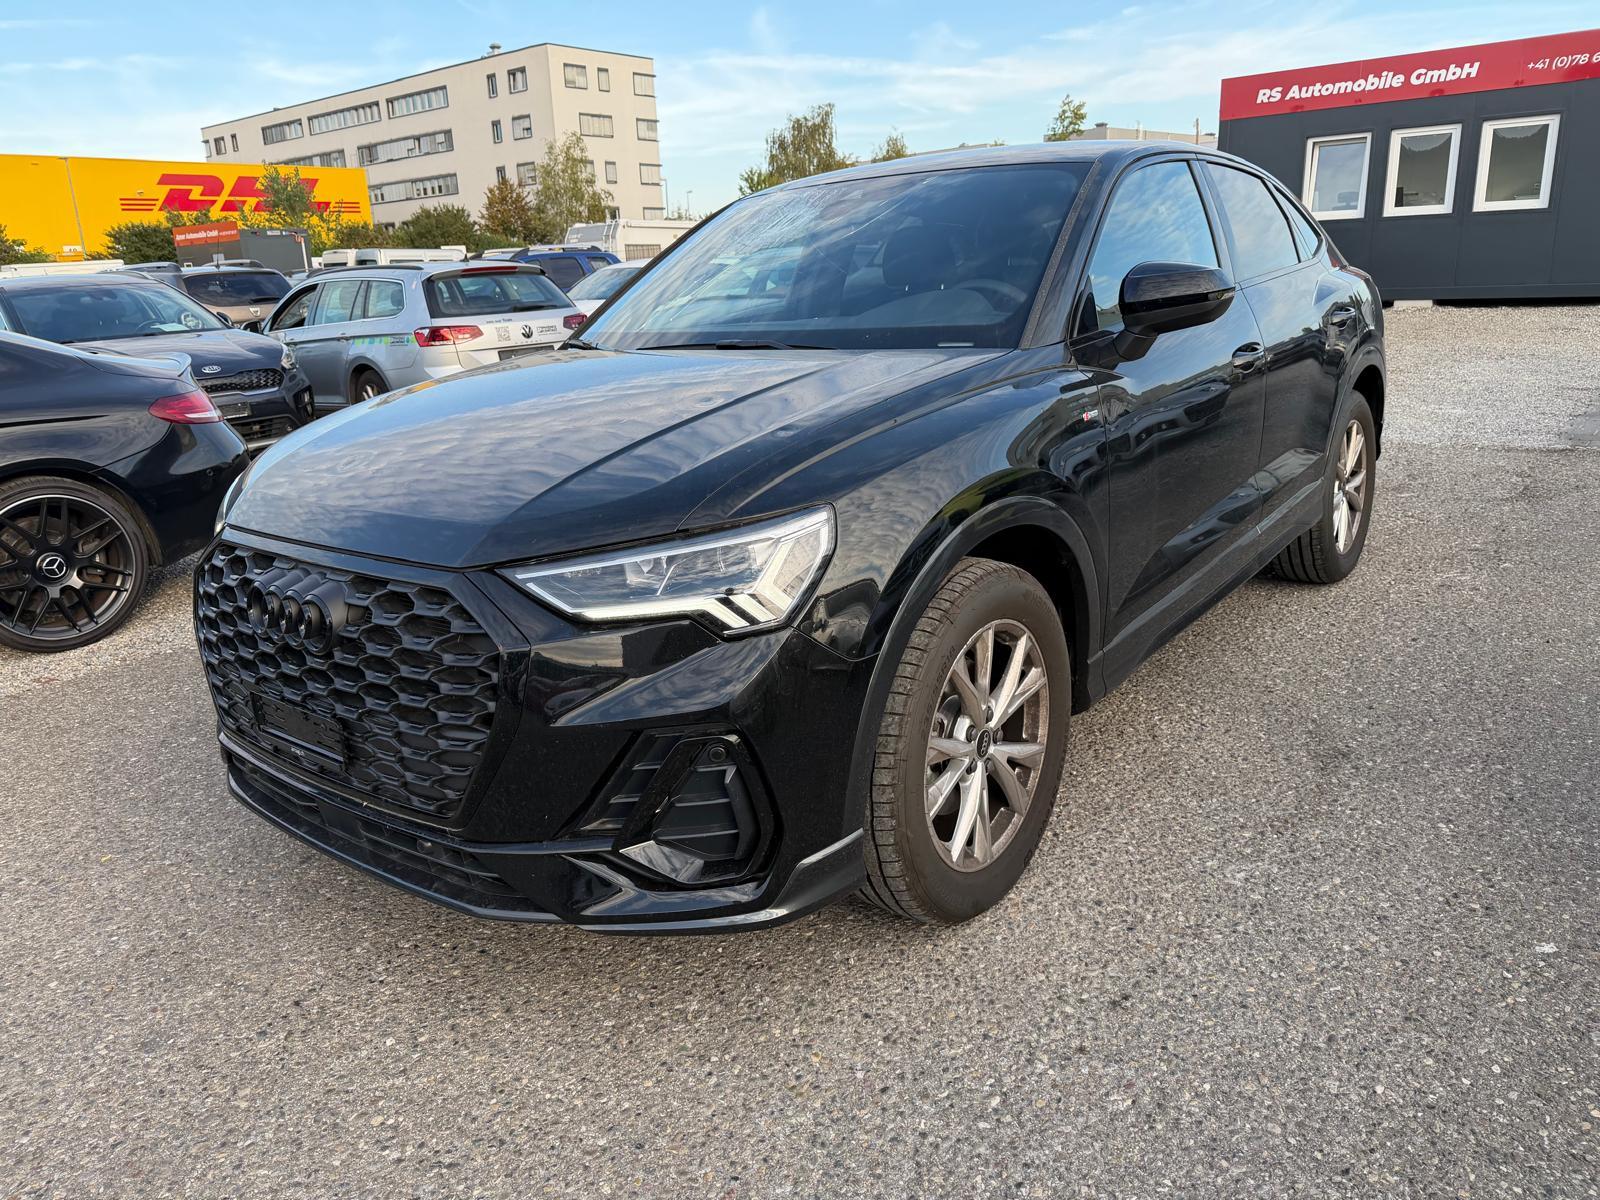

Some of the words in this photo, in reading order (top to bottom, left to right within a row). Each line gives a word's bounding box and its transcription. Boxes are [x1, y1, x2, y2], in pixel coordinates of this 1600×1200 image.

[1528, 58, 1550, 70] +41
[1552, 53, 1590, 70] (0)78
[1256, 87, 1283, 104] RS
[1285, 71, 1405, 100] Automobile
[1410, 62, 1480, 85] GmbH
[157, 173, 331, 212] DHL
